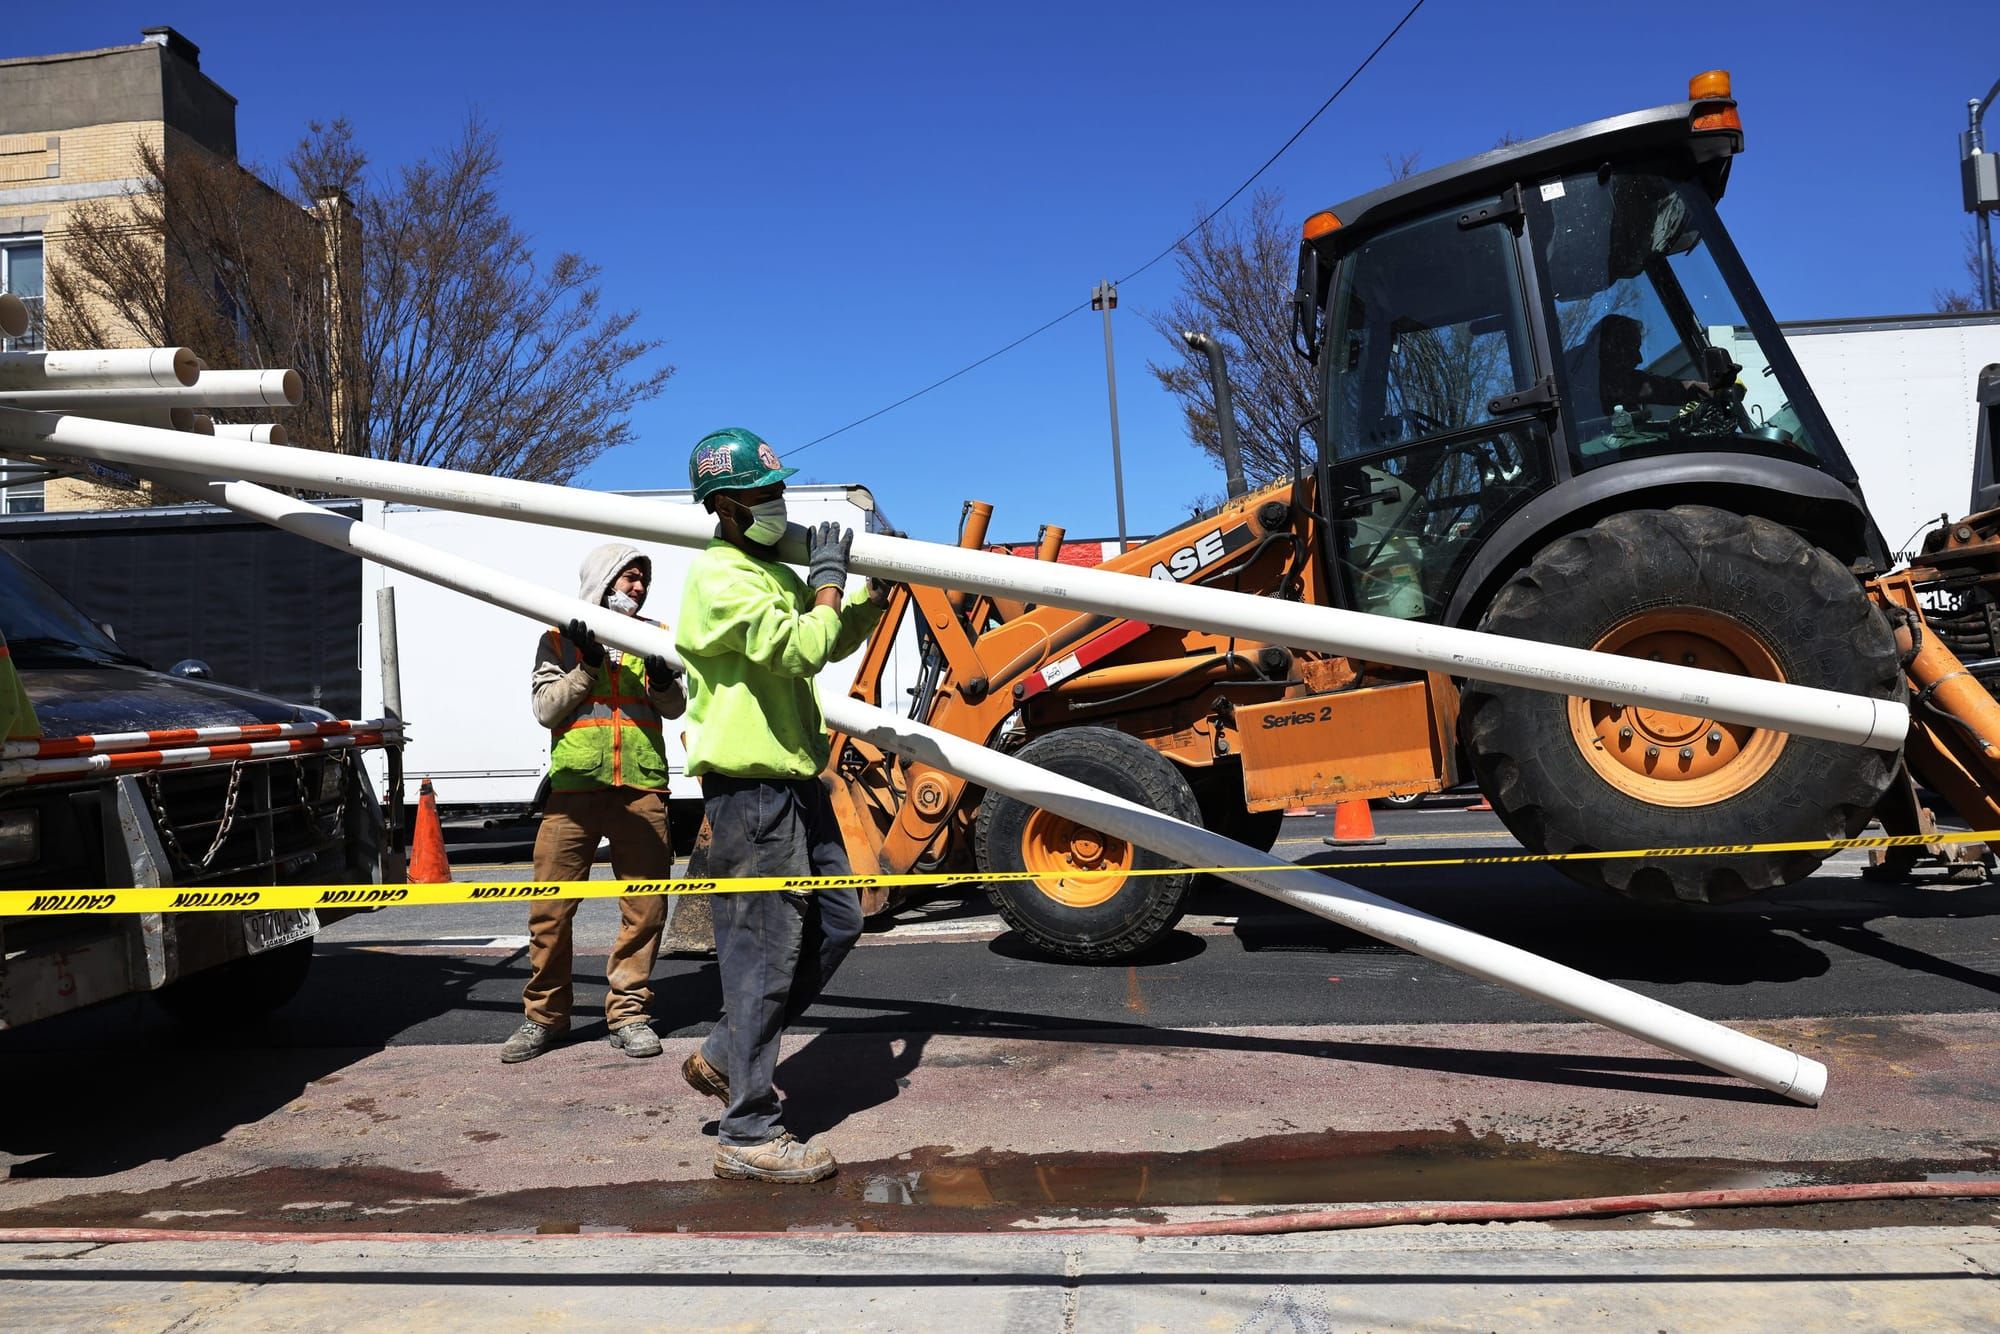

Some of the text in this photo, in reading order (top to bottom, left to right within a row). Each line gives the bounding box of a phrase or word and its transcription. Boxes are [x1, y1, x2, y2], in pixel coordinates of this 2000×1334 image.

[1149, 527, 1226, 582] ASE
[1506, 661, 1538, 675] TELEDUCT
[1262, 706, 1332, 730] Series 2
[1831, 835, 1944, 848] CAUTION
[468, 886, 561, 899] CAUTION
[624, 882, 717, 894] CAUTION
[27, 894, 116, 911] CAUTION
[169, 892, 260, 908] CAUTION
[316, 889, 408, 904] CAUTION
